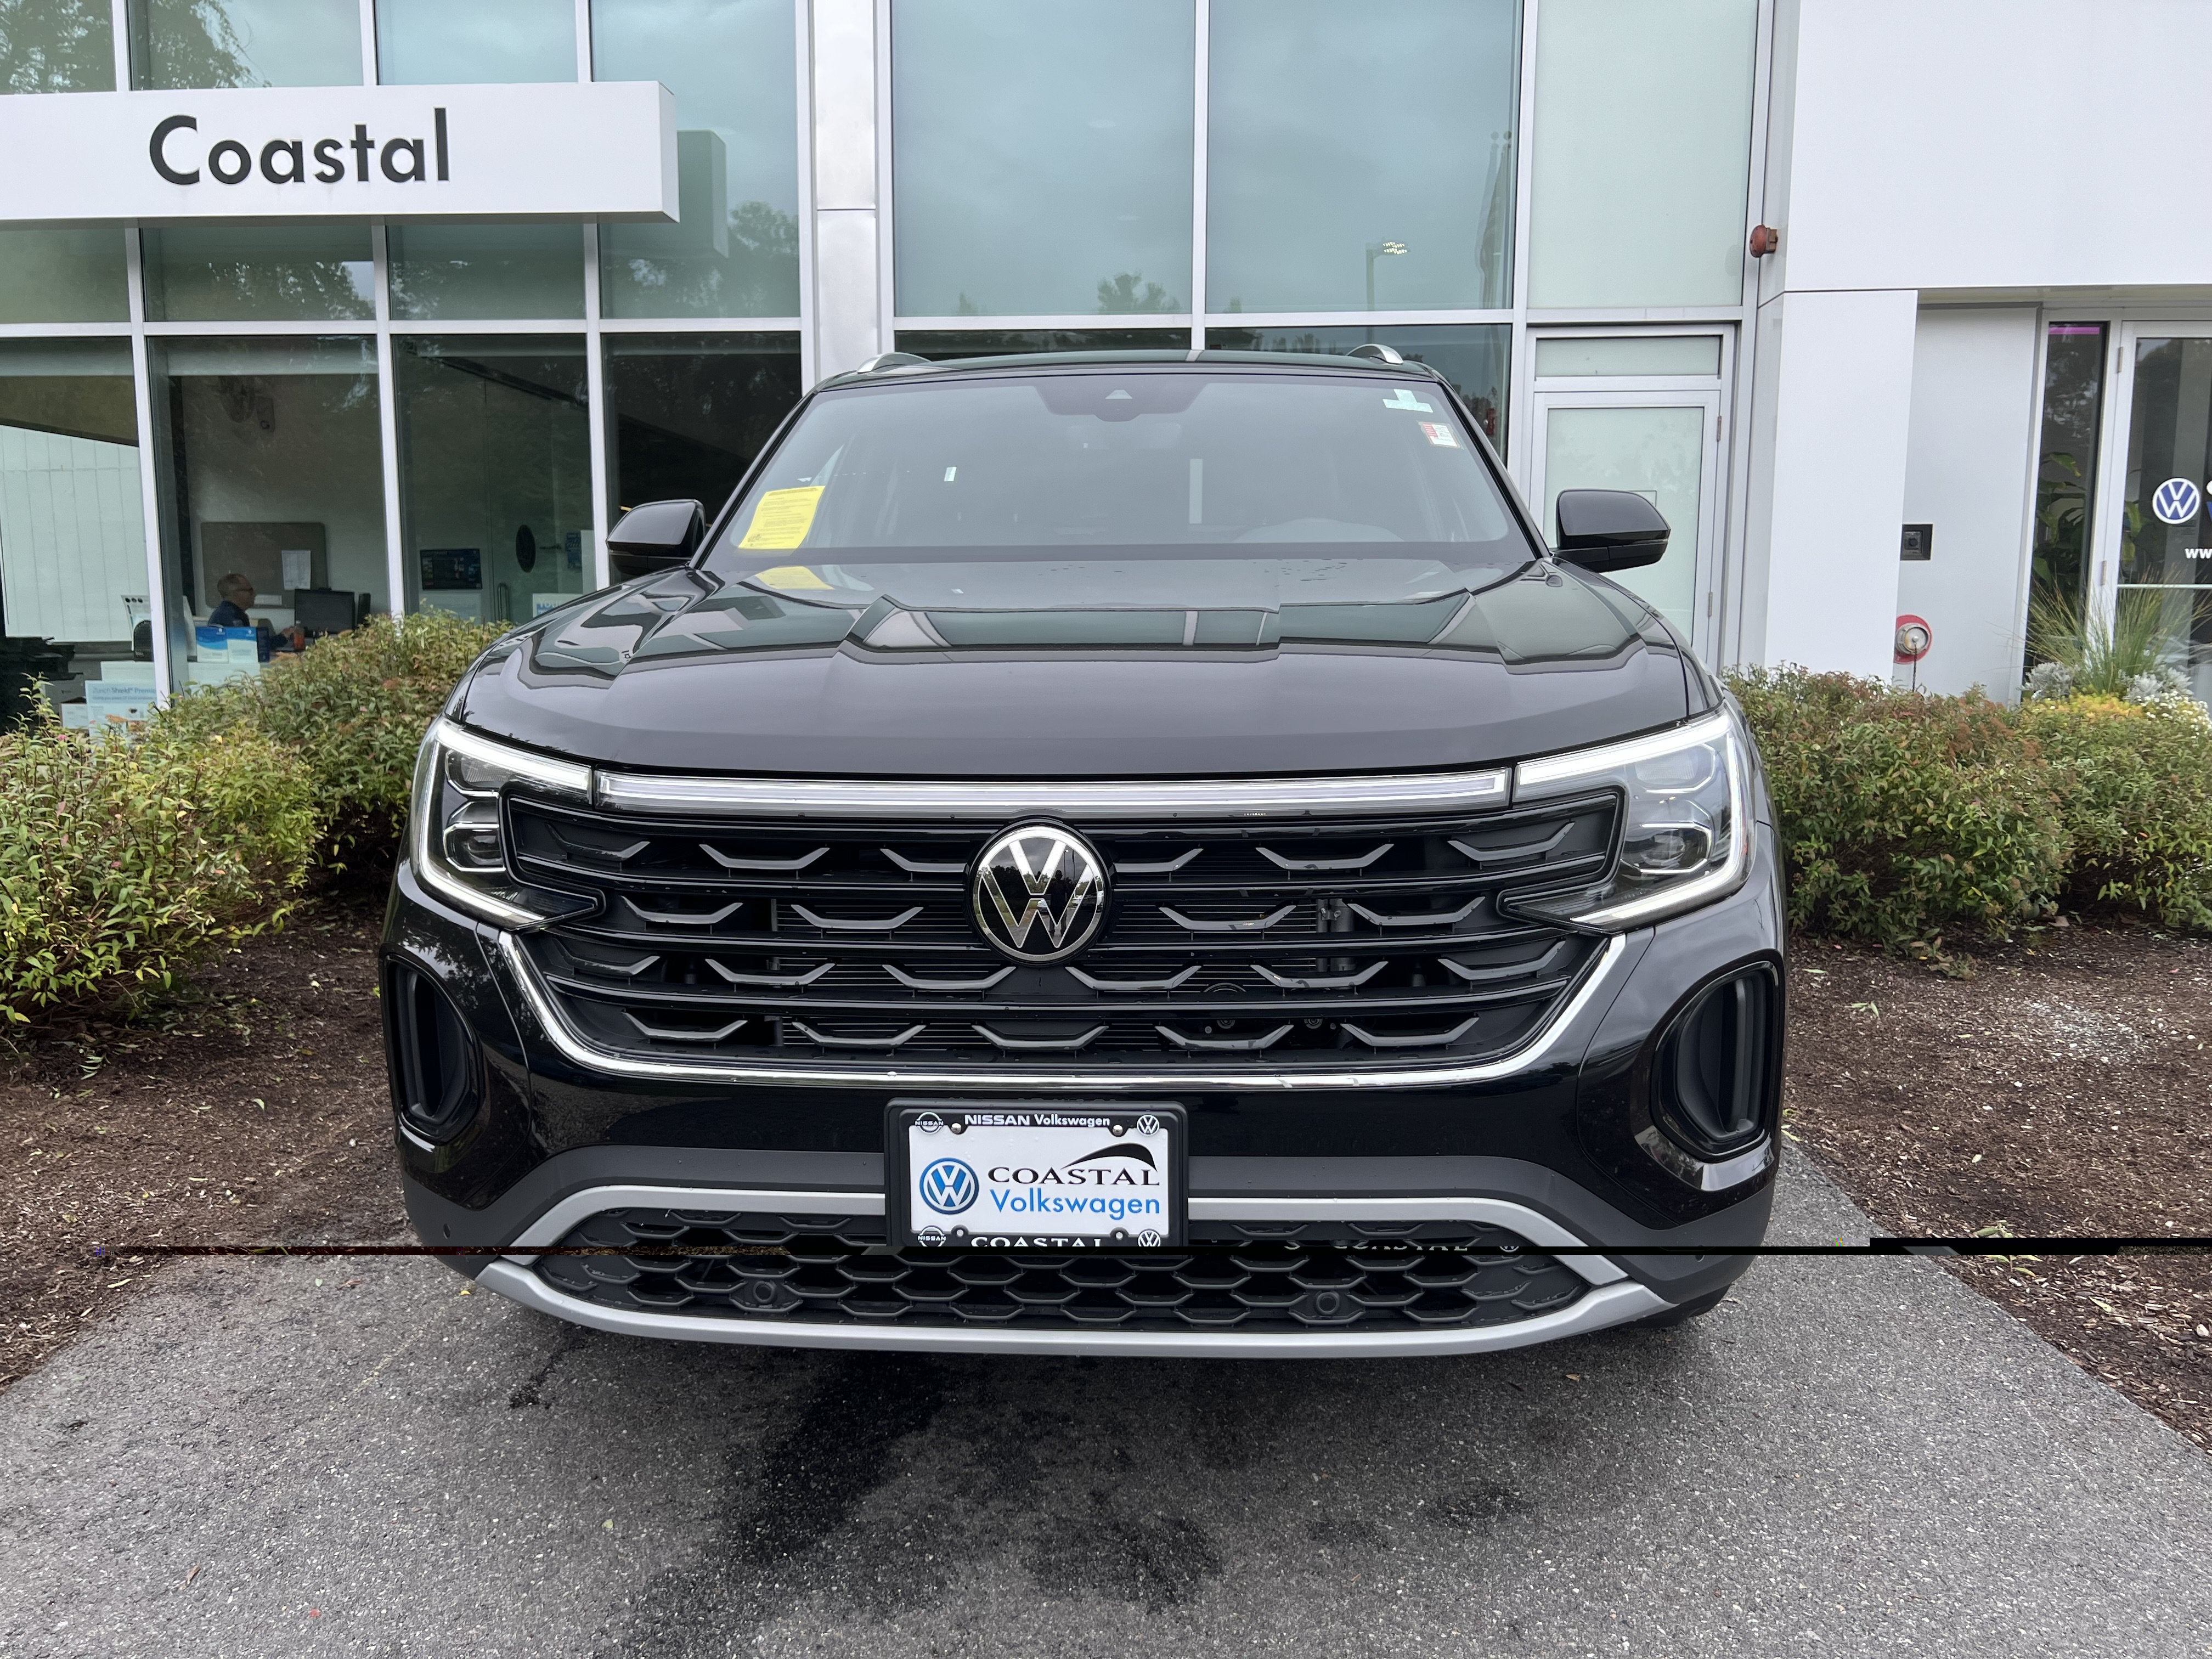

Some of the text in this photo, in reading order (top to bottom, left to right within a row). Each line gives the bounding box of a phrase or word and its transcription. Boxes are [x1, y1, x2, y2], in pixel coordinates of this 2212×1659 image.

[149, 107, 449, 185] Coastal
[964, 1114, 1110, 1127] NISSAN Volkswagen
[988, 1166, 1160, 1186] COASTAL
[990, 1187, 1160, 1221] Volkswagen
